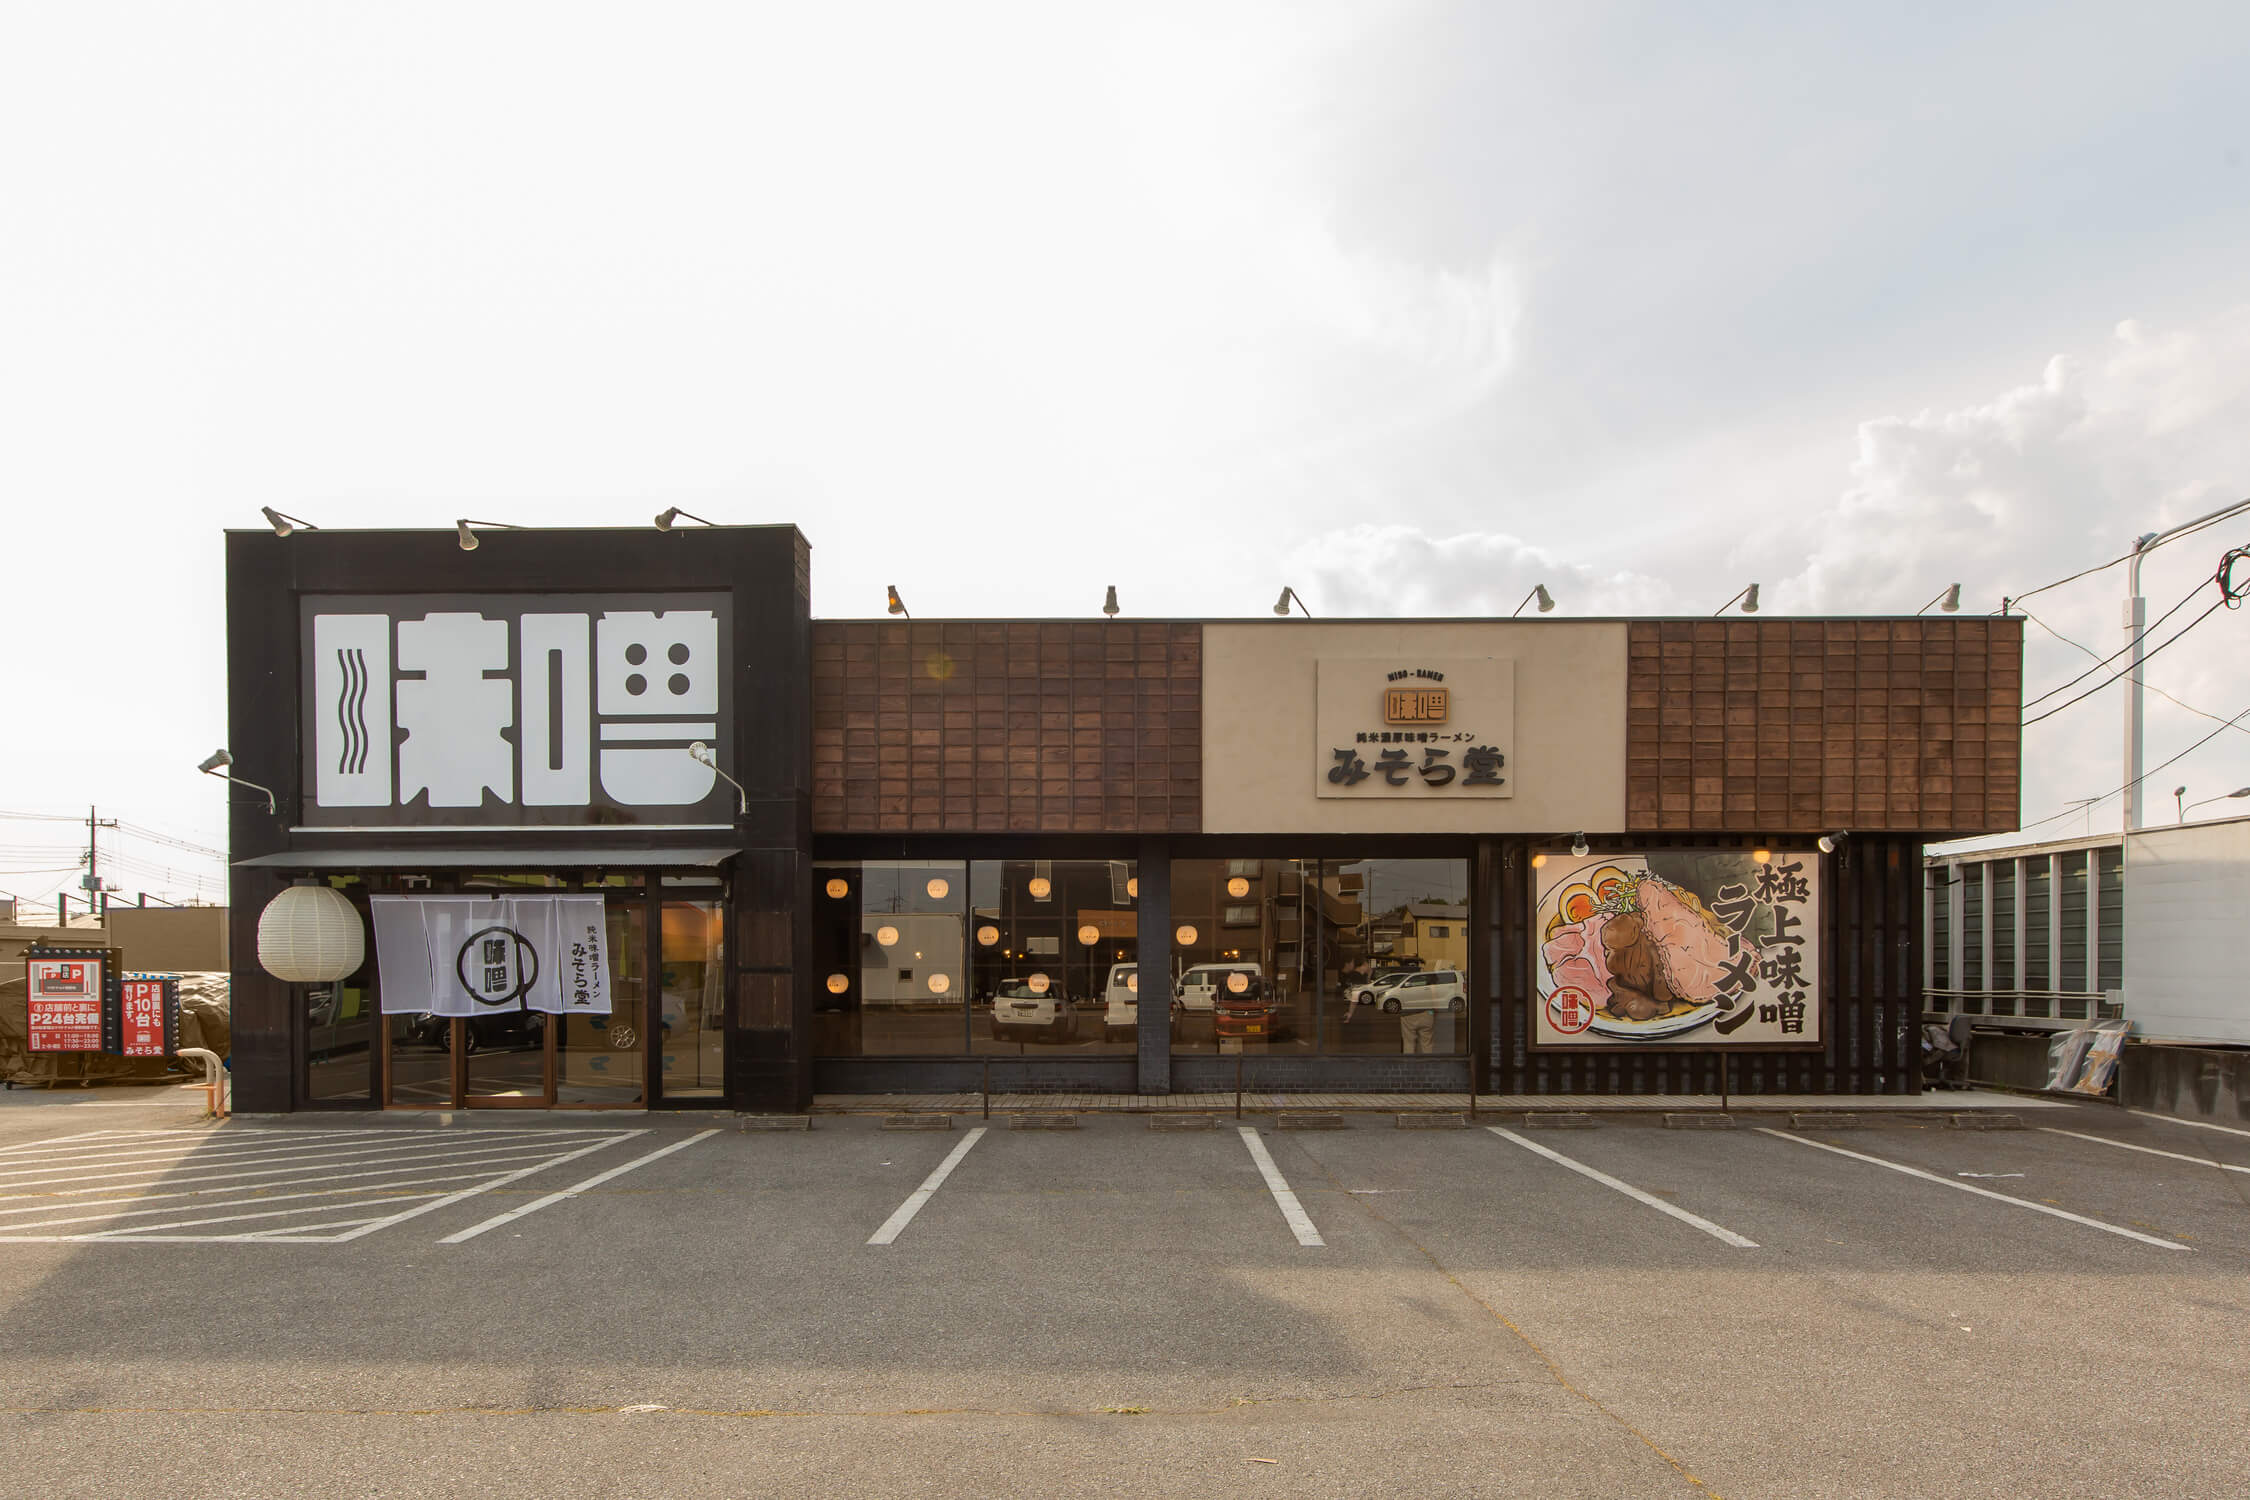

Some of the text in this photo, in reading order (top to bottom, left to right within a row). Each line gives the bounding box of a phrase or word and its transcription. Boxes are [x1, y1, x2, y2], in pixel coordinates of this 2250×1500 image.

[1387, 669, 1408, 682] MISO
[1416, 669, 1444, 683] RAMEN
[1327, 745, 1505, 786] みそら堂
[483, 939, 508, 993] 味噌
[1711, 884, 1757, 1035] ラーメン
[1755, 862, 1811, 1034] 極上味噌
[72, 969, 82, 979] P
[571, 943, 591, 1006] みそら堂
[126, 1046, 163, 1056] みそら堂
